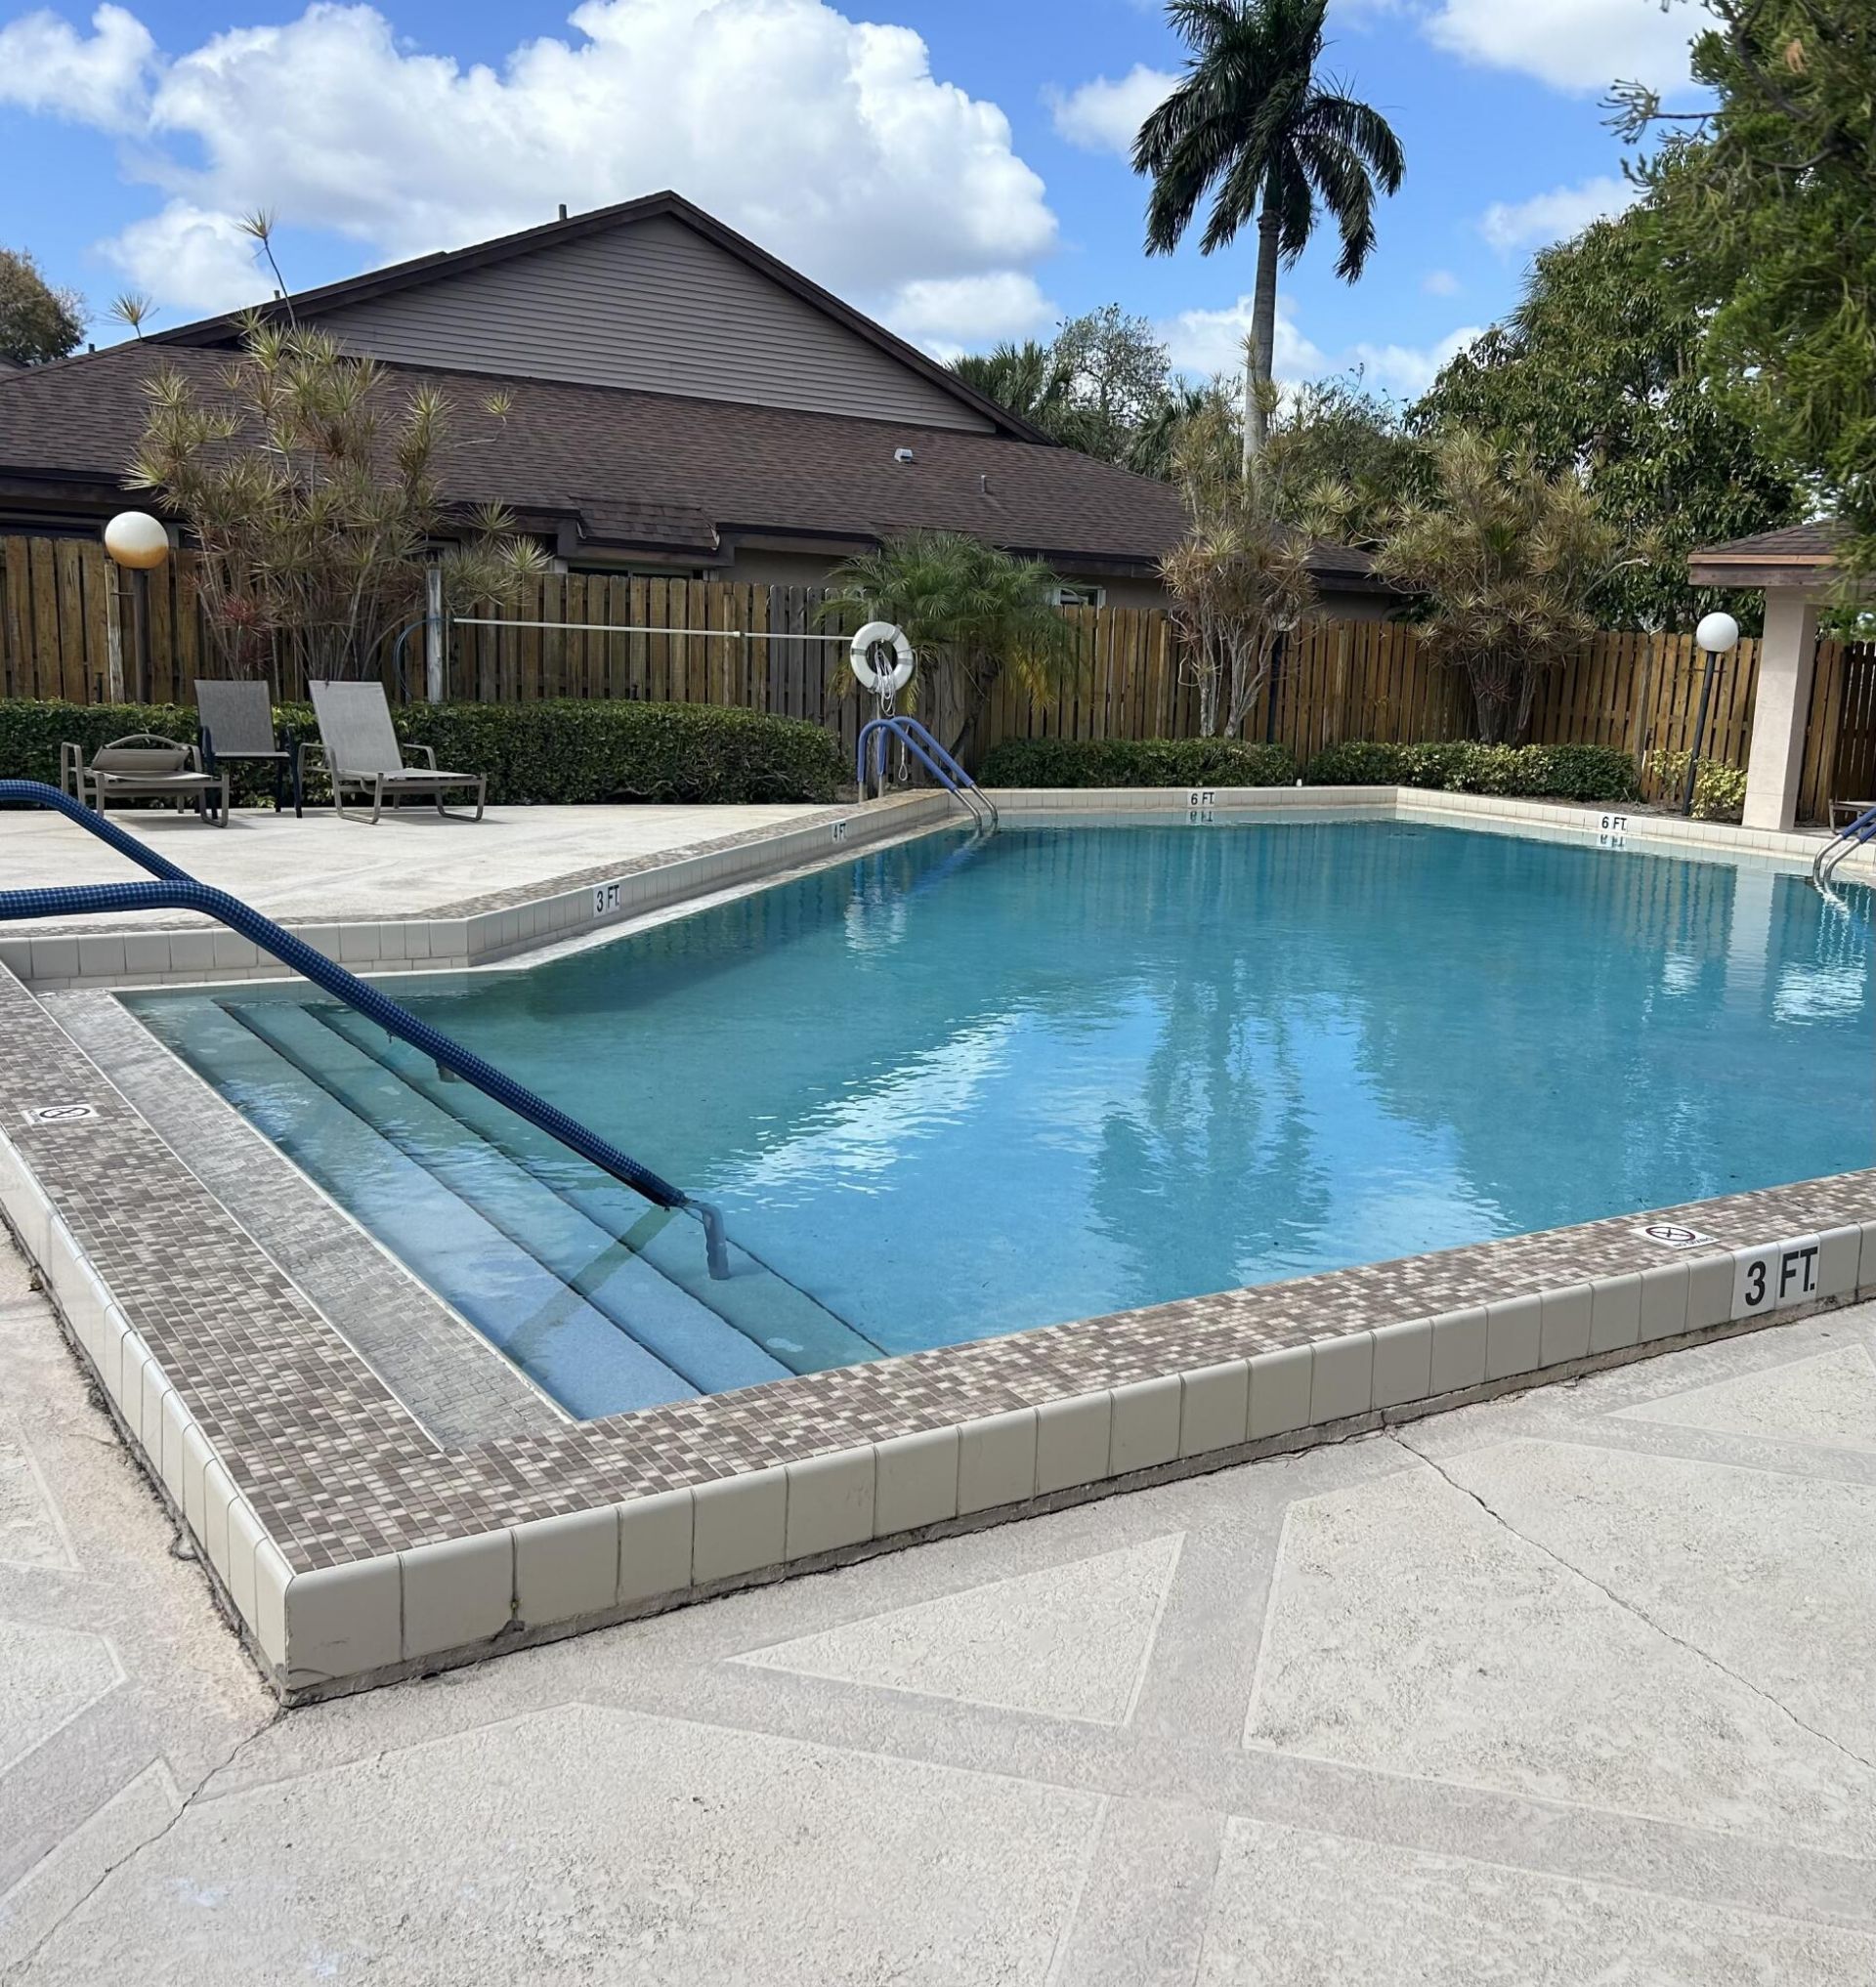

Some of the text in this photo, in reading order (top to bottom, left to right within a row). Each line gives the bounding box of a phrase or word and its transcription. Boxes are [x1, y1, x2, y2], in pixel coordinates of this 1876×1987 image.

[1191, 792, 1198, 806] 6
[1601, 816, 1609, 829] 6
[596, 890, 604, 912] 3
[1745, 1246, 1818, 1306] 3 FT.
